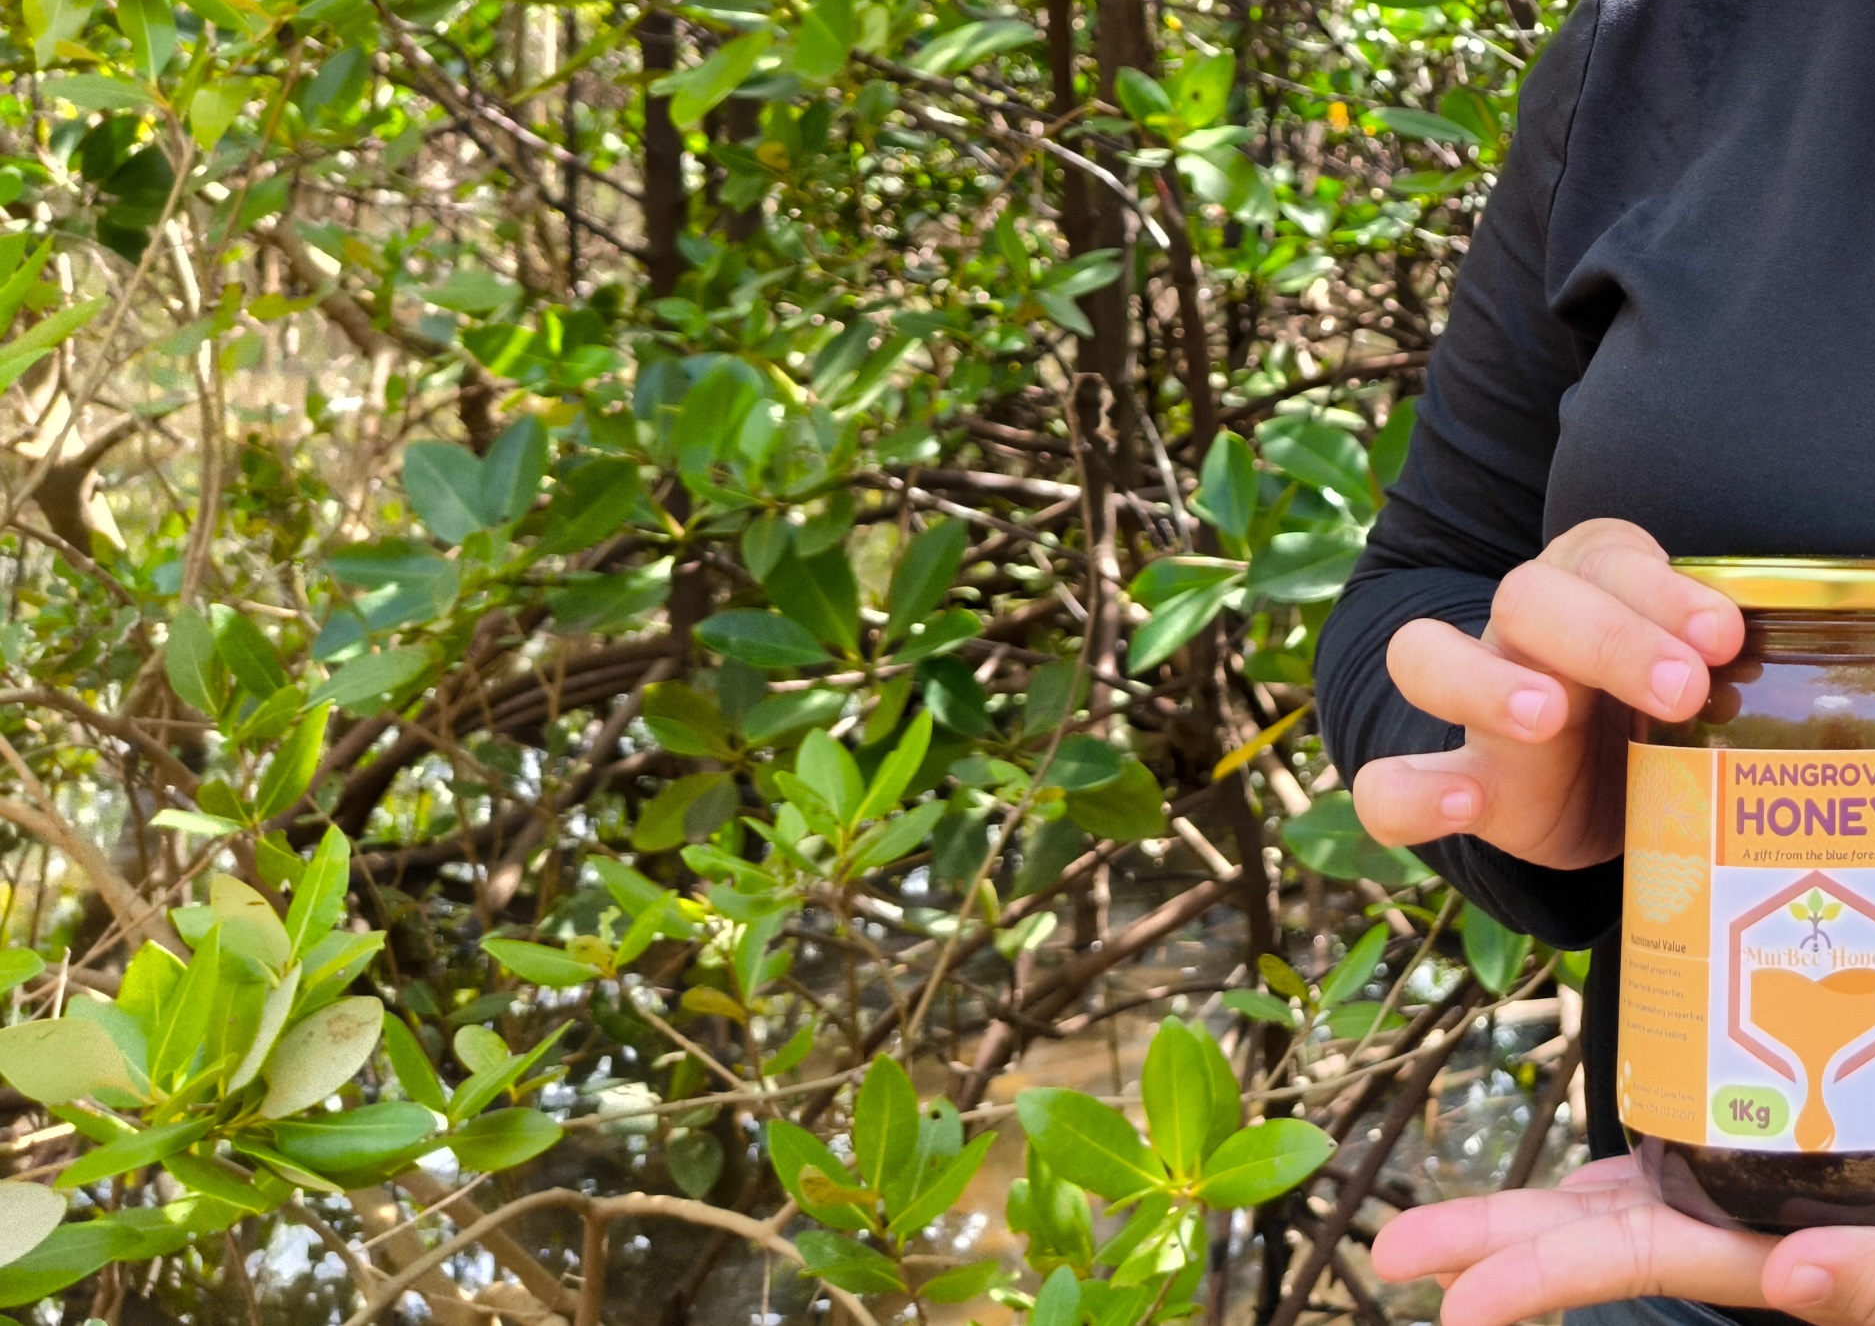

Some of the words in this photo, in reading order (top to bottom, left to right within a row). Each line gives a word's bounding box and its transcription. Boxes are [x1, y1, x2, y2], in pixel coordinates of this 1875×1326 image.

[1743, 849, 1750, 859] A
[1754, 849, 1772, 862] gift
[1775, 849, 1803, 862] from
[1806, 849, 1823, 860] the
[1826, 849, 1848, 860] blue
[1662, 939, 1686, 953] Value
[1729, 1098, 1770, 1130] 1Kg
